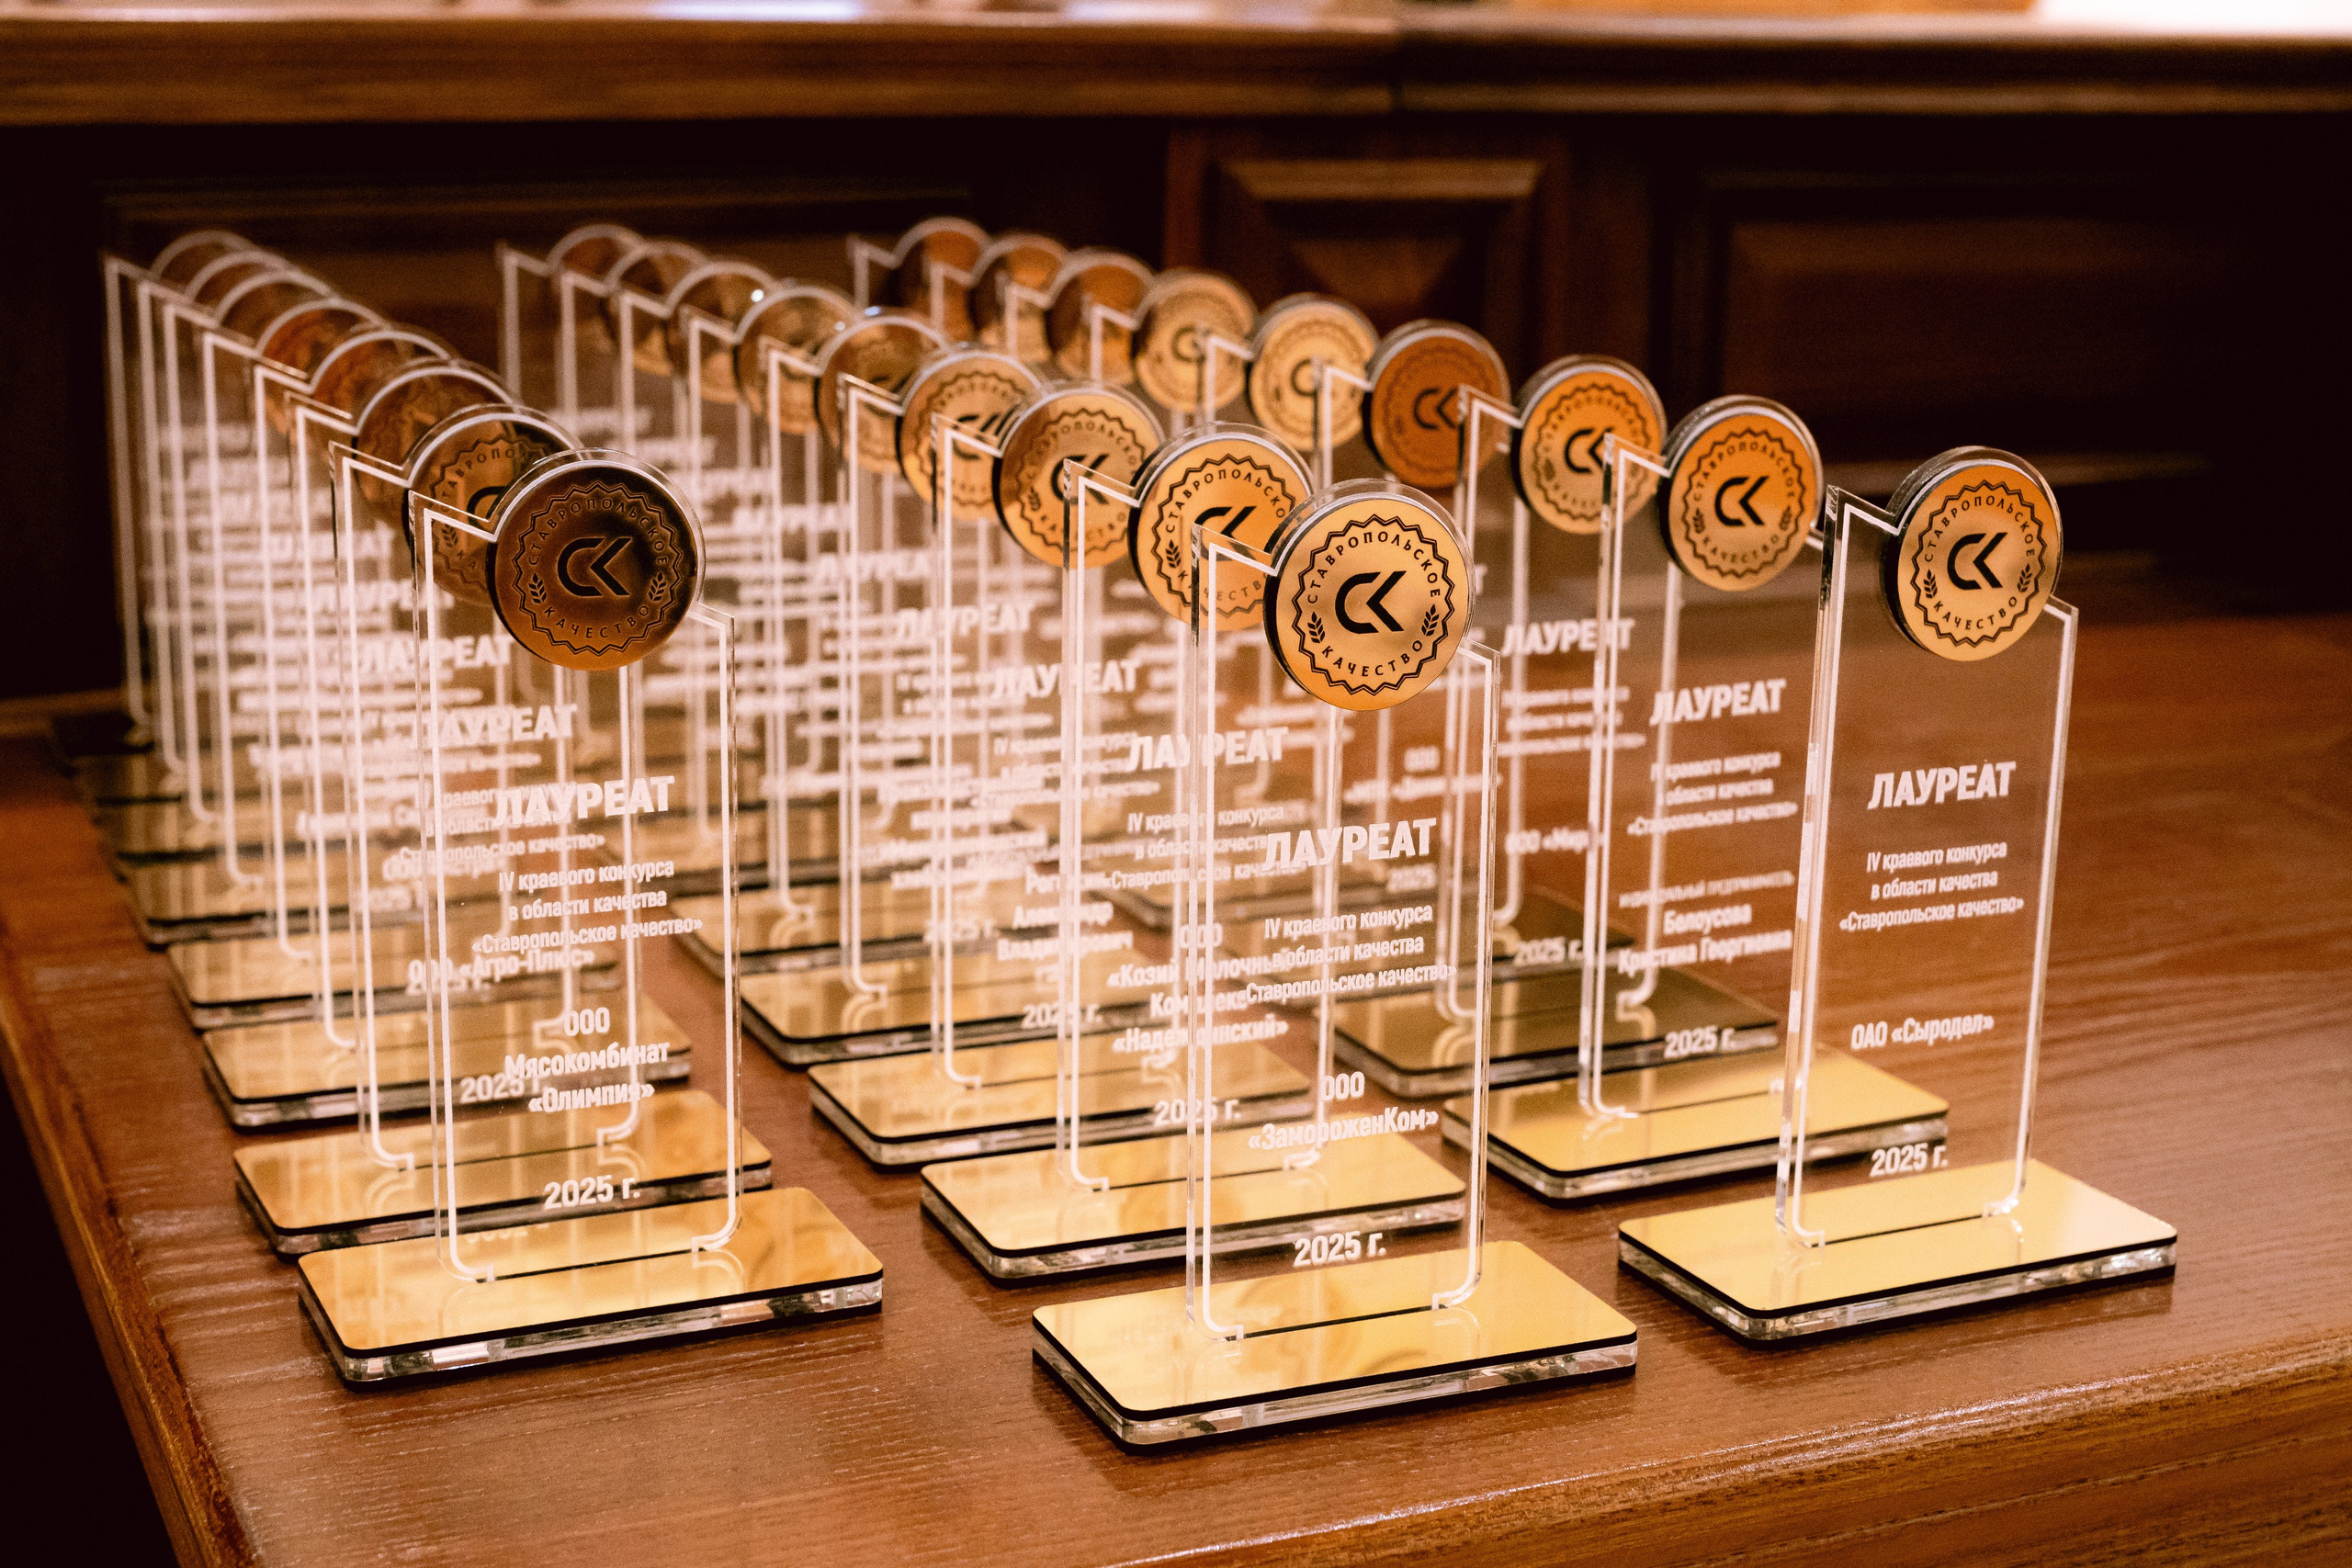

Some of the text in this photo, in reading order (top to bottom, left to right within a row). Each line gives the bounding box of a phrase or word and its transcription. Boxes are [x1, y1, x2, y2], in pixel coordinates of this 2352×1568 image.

[1693, 439, 1795, 502] СТАВРОПОЛЬСКОЕ
[1165, 467, 1286, 534] СТАВРОПОЛЬСКО
[1713, 475, 1770, 527] СК
[526, 496, 669, 567] СТАВРОПОЛЬСКОЕ
[1924, 495, 2035, 563] СТАВРОПОЛЬСКОЕ
[556, 535, 634, 598] СК
[1306, 531, 1442, 605] СТАВРОПОЛЬСКОЕ
[1702, 533, 1781, 566] КАЧЕСТВО
[1946, 531, 2008, 591] СК
[1178, 570, 1267, 602] КЧЕСТВ
[1334, 570, 1408, 635] СК
[544, 604, 650, 640] КАЧЕСТВО
[1933, 595, 2018, 631] КАЧЕСТВО
[1320, 639, 1423, 677] КАЧЕСТВО
[990, 657, 1141, 699] ЛАУЕАТ
[1650, 678, 1787, 726] ЛАУРЕАТ
[1125, 726, 1289, 772] ЛАУРЕАТ
[492, 774, 675, 828] ЛАУРЕАТ
[1867, 760, 2017, 810] ЛАУРЕАТ
[1146, 810, 1214, 835] краевг
[1261, 818, 1437, 872] ЛАУРЕАТ
[1866, 840, 2007, 873] IV краевого конкурса
[499, 871, 514, 892] IV
[518, 863, 596, 894] краевого
[599, 859, 675, 887] конкурса
[1871, 870, 1998, 900] в области качества
[508, 890, 667, 920] в области качества
[1264, 905, 1433, 942] IV краевого конкурса
[1838, 896, 2025, 932] «Ставропольское качество»
[471, 917, 704, 956] «Ставропольское качество»
[1286, 943, 1351, 970] области
[1353, 936, 1424, 961] качества
[1377, 963, 1458, 989] качество»
[1021, 1001, 1082, 1029] 202
[1850, 1012, 1995, 1050] ОАО «Сыродел»
[504, 1041, 671, 1080] Мясокомбинат
[1664, 1025, 1718, 1059] 2025
[460, 1070, 523, 1103] 2025
[527, 1080, 656, 1114] «Олимпия»
[1247, 1105, 1440, 1152] «ЗамороженКом»
[1870, 1142, 1950, 1179] 2025 г.
[544, 1174, 641, 1211] 2025 г.
[1293, 1230, 1388, 1269] 2025 г.
